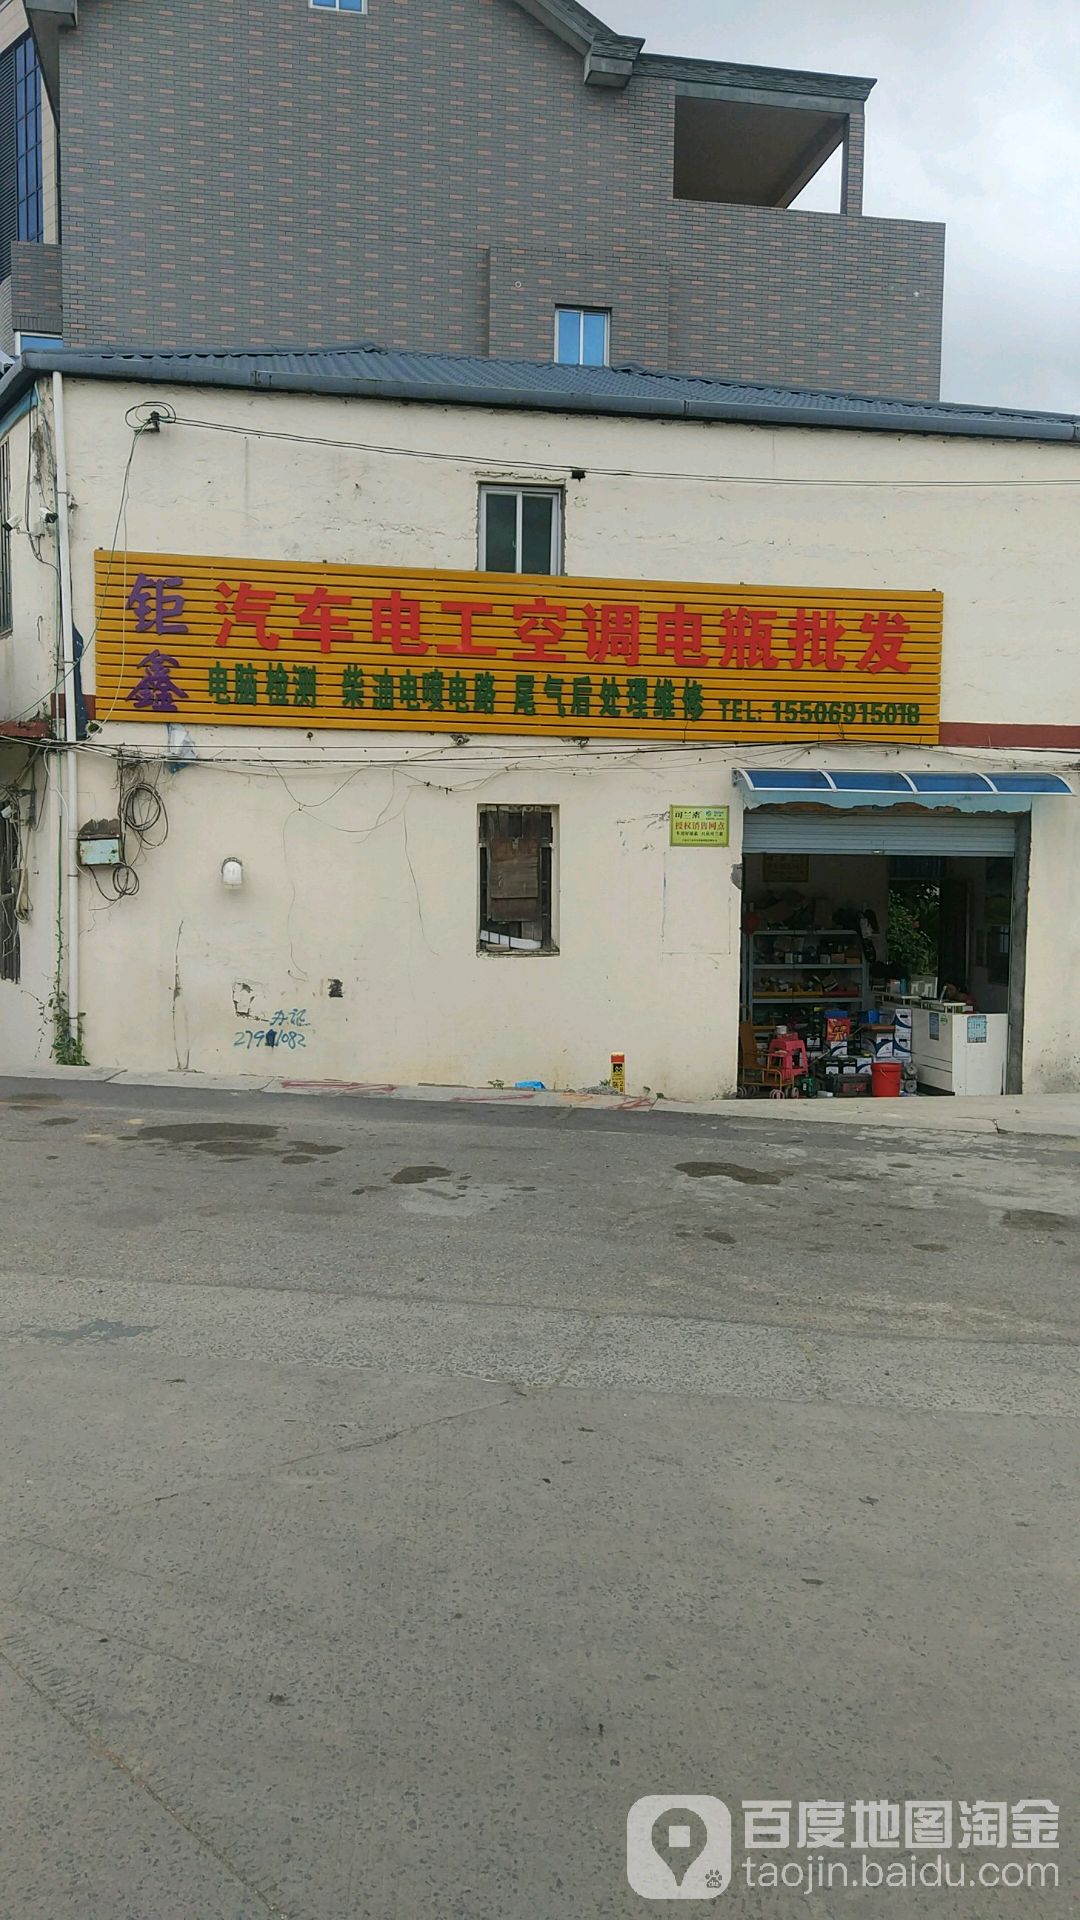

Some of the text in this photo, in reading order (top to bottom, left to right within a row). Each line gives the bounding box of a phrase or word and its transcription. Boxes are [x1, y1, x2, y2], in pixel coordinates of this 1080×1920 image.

[126, 572, 190, 712] 钜鑫
[214, 580, 912, 674] 汽车电工空调电瓶批发
[208, 661, 921, 725] 电脑检测 柴油电喷电路 尾气后处理维修 TEL: 15506915018
